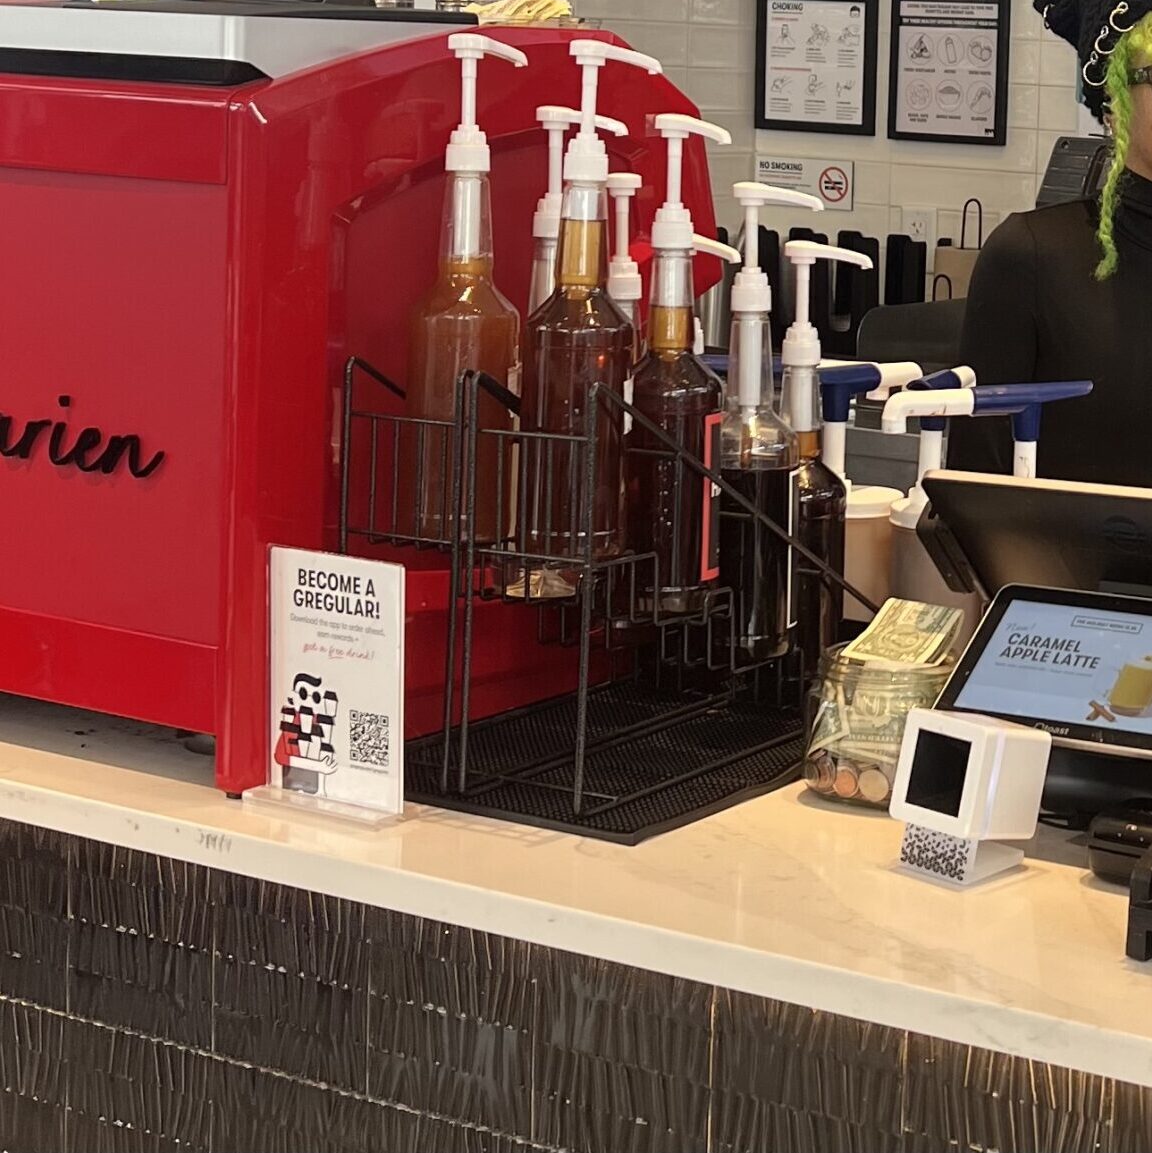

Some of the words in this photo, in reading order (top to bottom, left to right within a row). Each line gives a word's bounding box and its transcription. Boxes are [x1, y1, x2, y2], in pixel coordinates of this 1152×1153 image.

[772, 1, 803, 12] CHOKING
[759, 161, 770, 169] NO
[771, 161, 803, 171] SMOKING
[298, 567, 361, 595] BECOME
[365, 579, 376, 598] A
[293, 589, 380, 620] GREGULAR!
[1008, 632, 1081, 653] CARAMEL
[999, 646, 1051, 663] APPLE
[1052, 652, 1101, 669] LATTE
